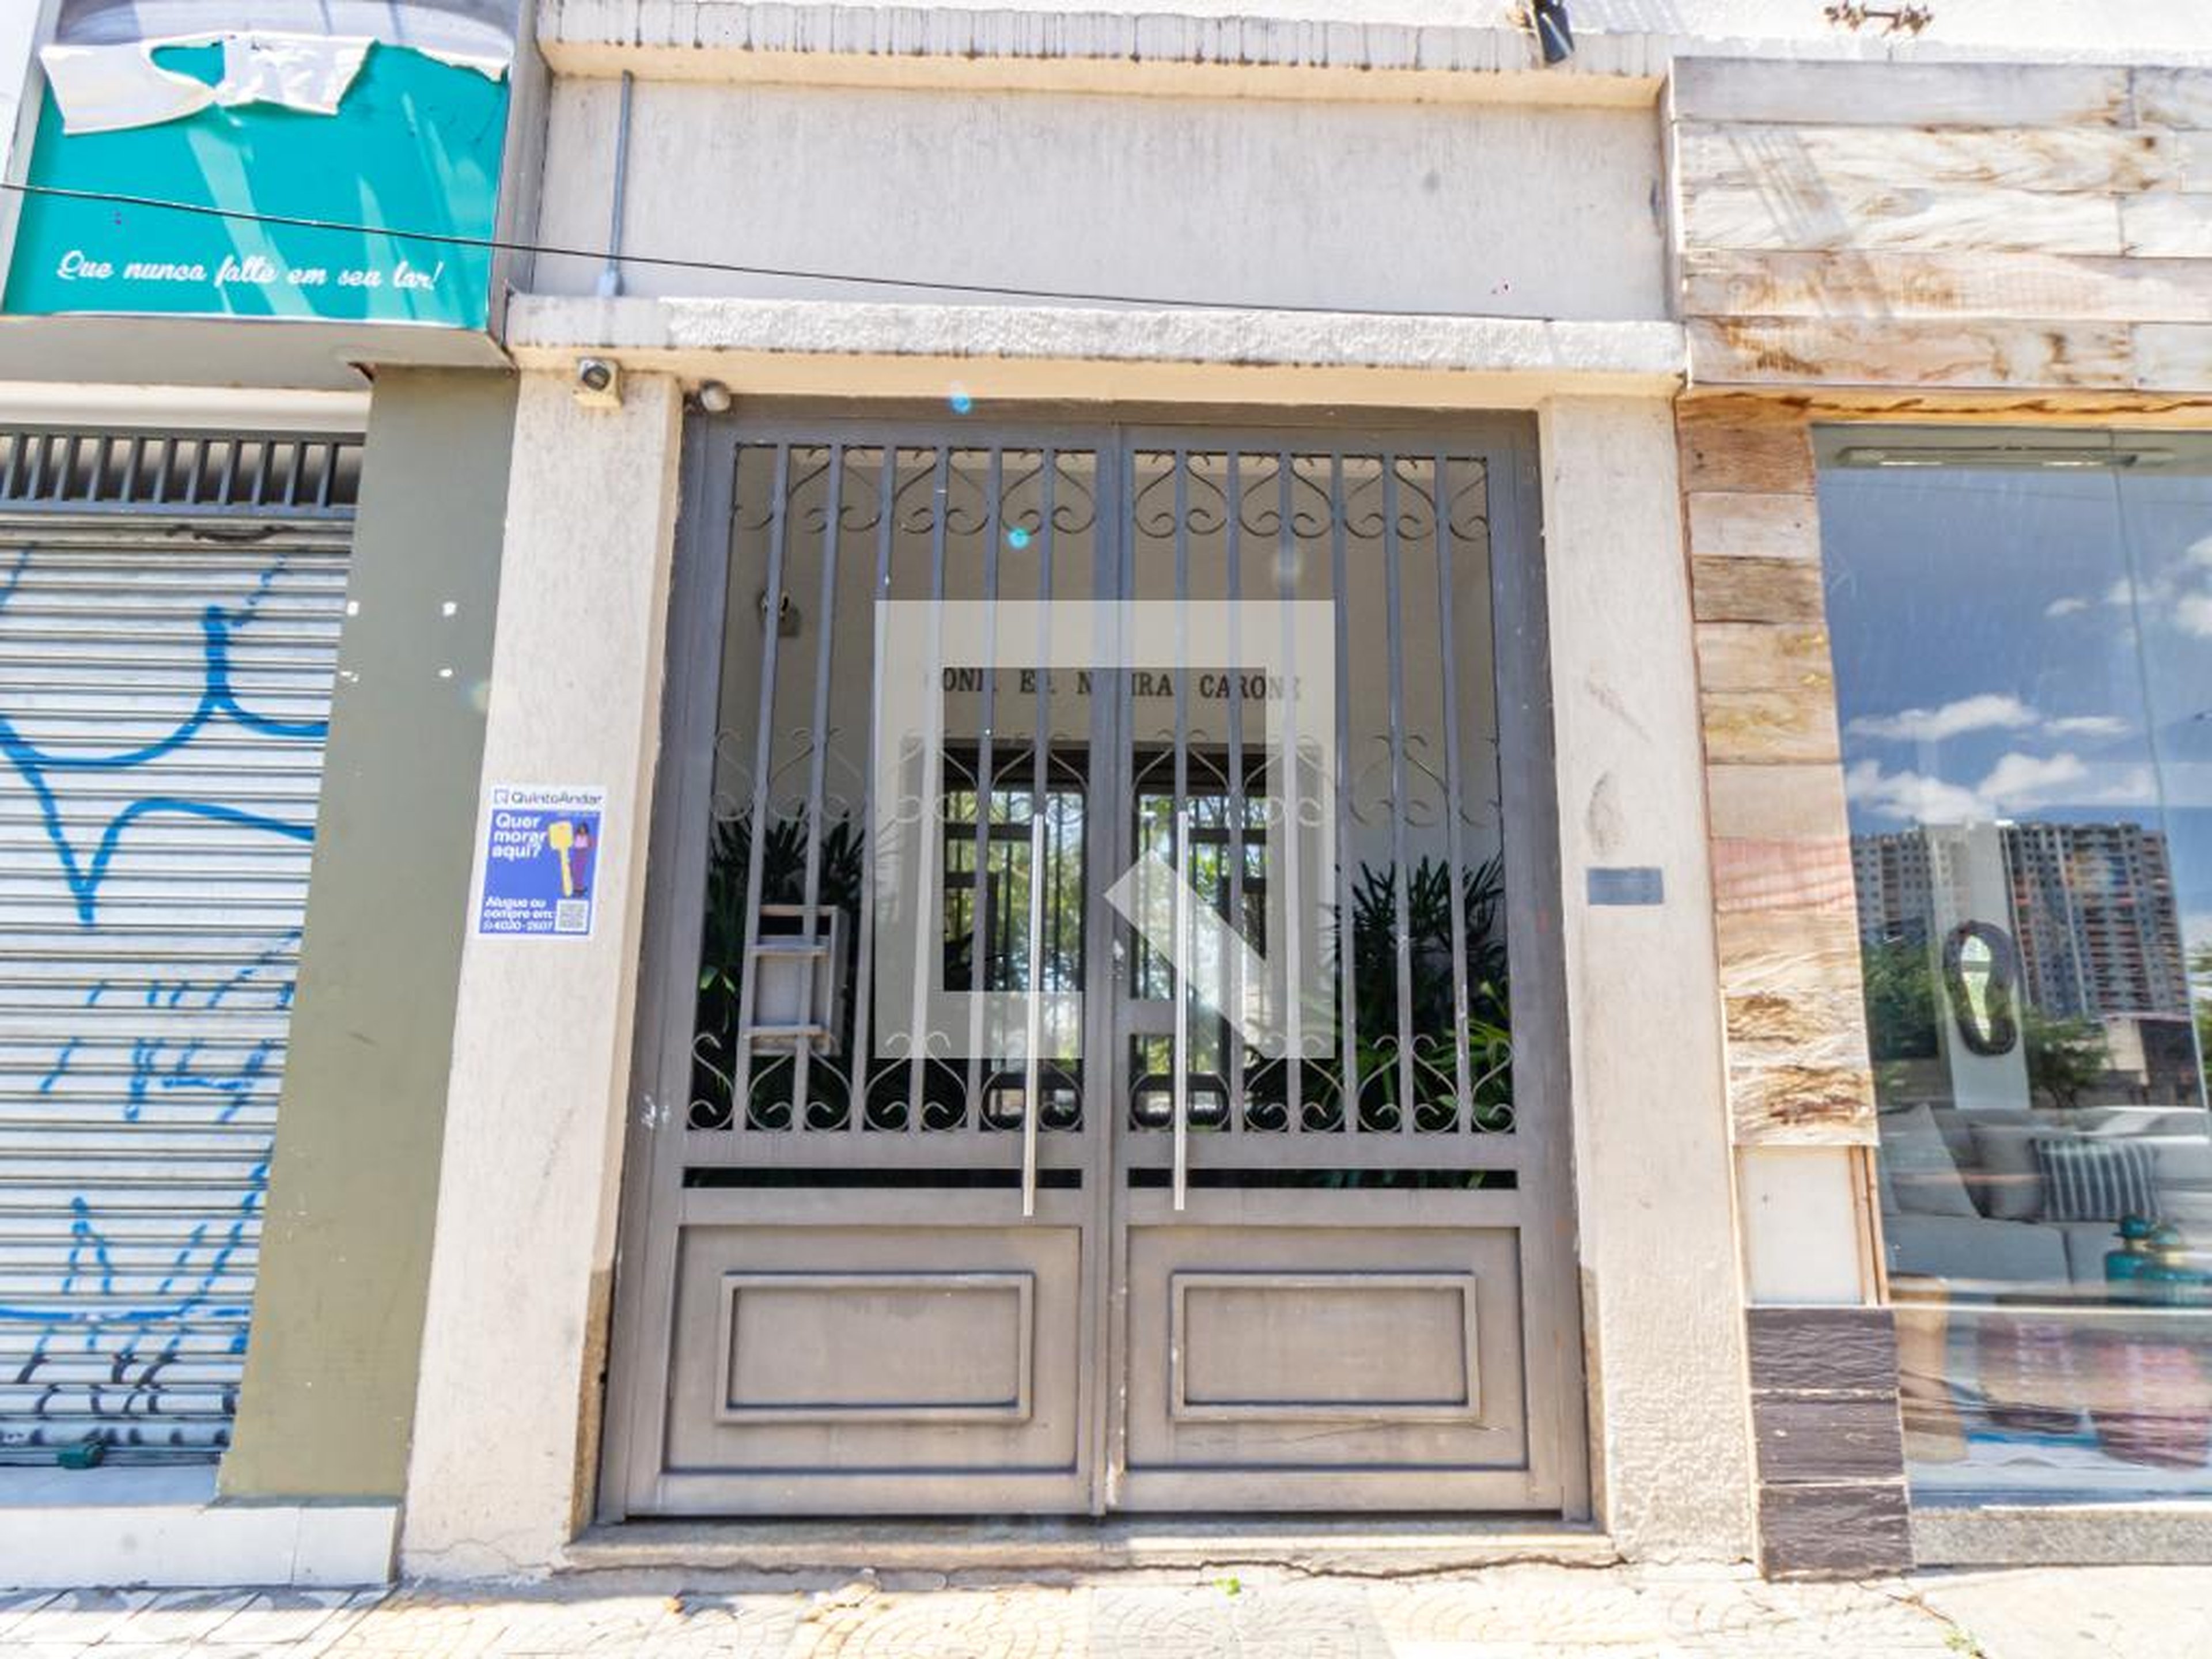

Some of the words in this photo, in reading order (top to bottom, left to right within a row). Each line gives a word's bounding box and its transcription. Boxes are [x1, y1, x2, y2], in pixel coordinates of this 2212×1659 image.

[56, 250, 114, 281] Que
[123, 259, 207, 282] nunca
[287, 266, 328, 286] em
[337, 265, 383, 287] seu
[393, 260, 445, 290] lar!
[512, 791, 603, 805] QuintoAndar
[495, 812, 542, 830] Quer
[493, 829, 548, 844] morar
[491, 843, 542, 861] aqui?
[485, 896, 528, 910] Alugue
[530, 899, 547, 908] ou
[483, 909, 531, 922] compre
